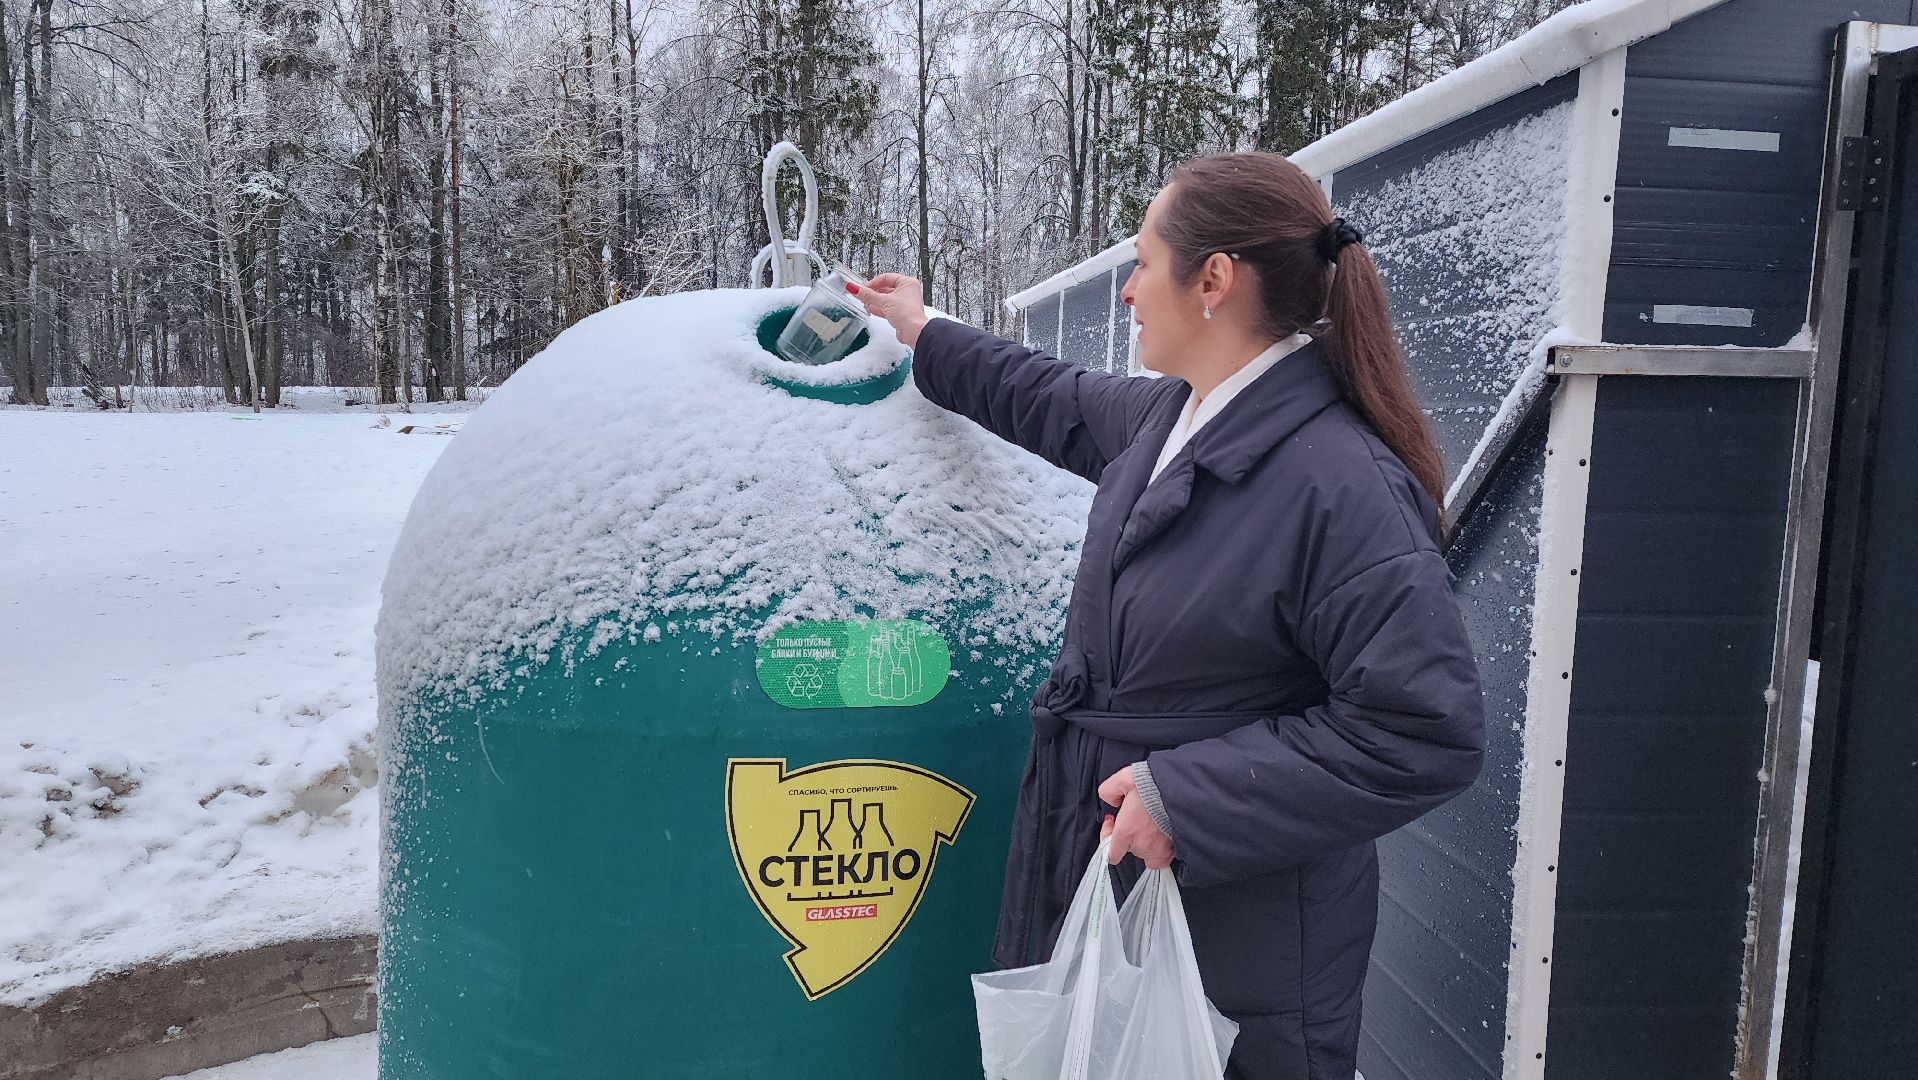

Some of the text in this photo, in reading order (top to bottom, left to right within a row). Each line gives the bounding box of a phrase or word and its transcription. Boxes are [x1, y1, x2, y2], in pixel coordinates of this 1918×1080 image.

[776, 638, 803, 647] ТОЛЬКО
[788, 788, 828, 796] СПАСИБО,
[830, 787, 845, 795] ЧТО
[759, 848, 921, 888] СТЕКЛО
[807, 905, 875, 920] GLASSTEC
